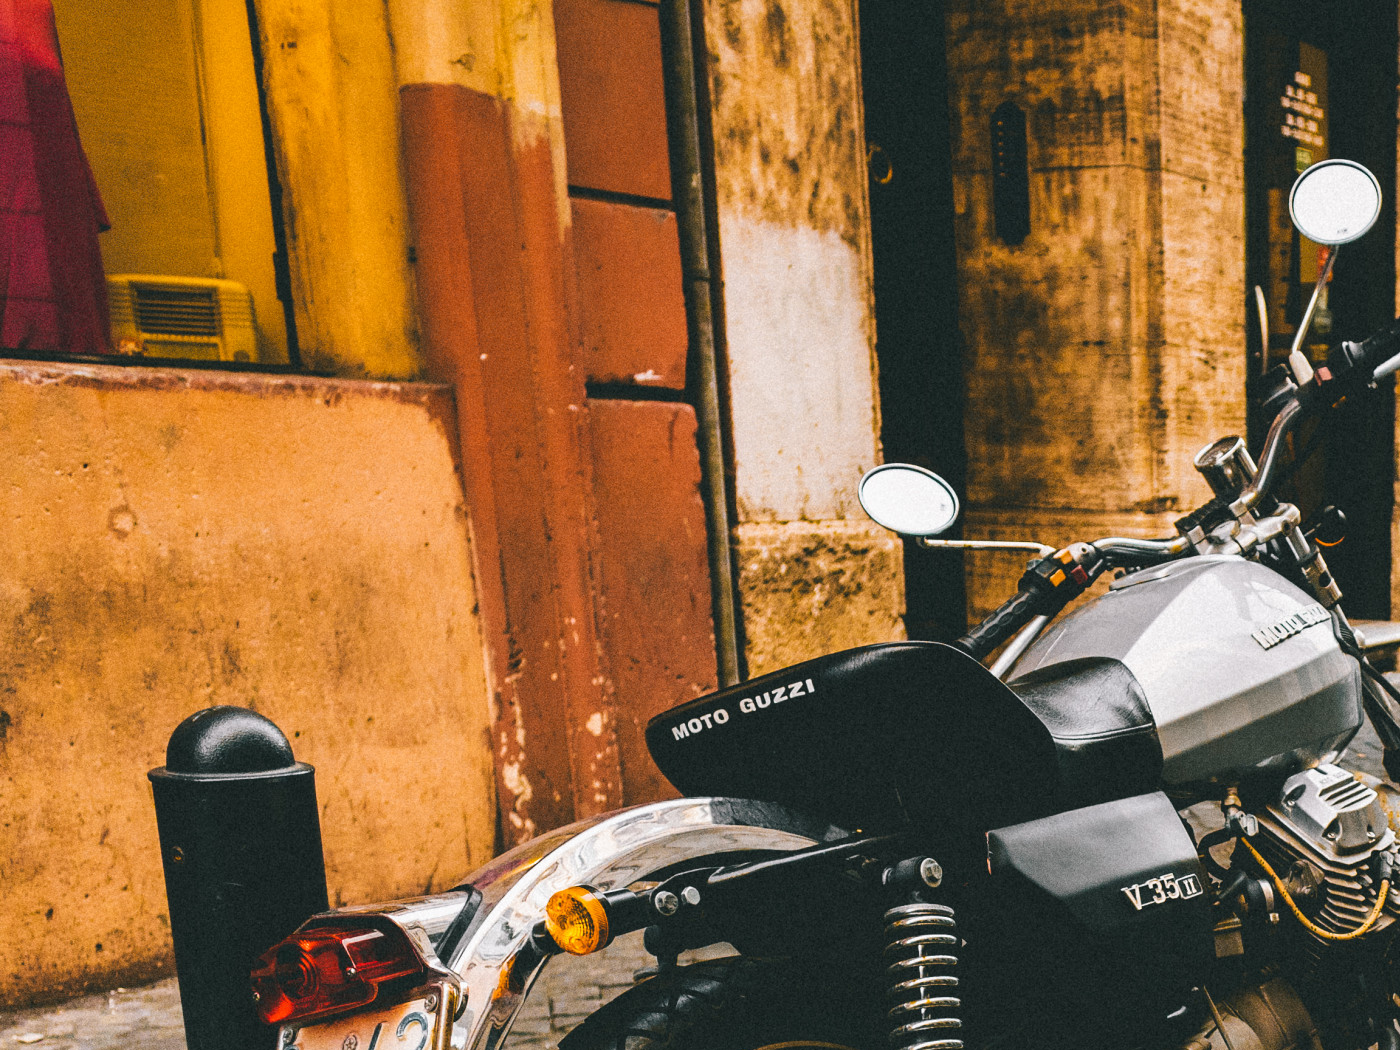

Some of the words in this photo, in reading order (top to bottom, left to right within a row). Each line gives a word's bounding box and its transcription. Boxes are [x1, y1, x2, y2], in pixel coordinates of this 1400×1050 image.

[1251, 613, 1302, 651] MOTO
[671, 709, 730, 741] MOTO
[739, 678, 815, 714] GUZZI
